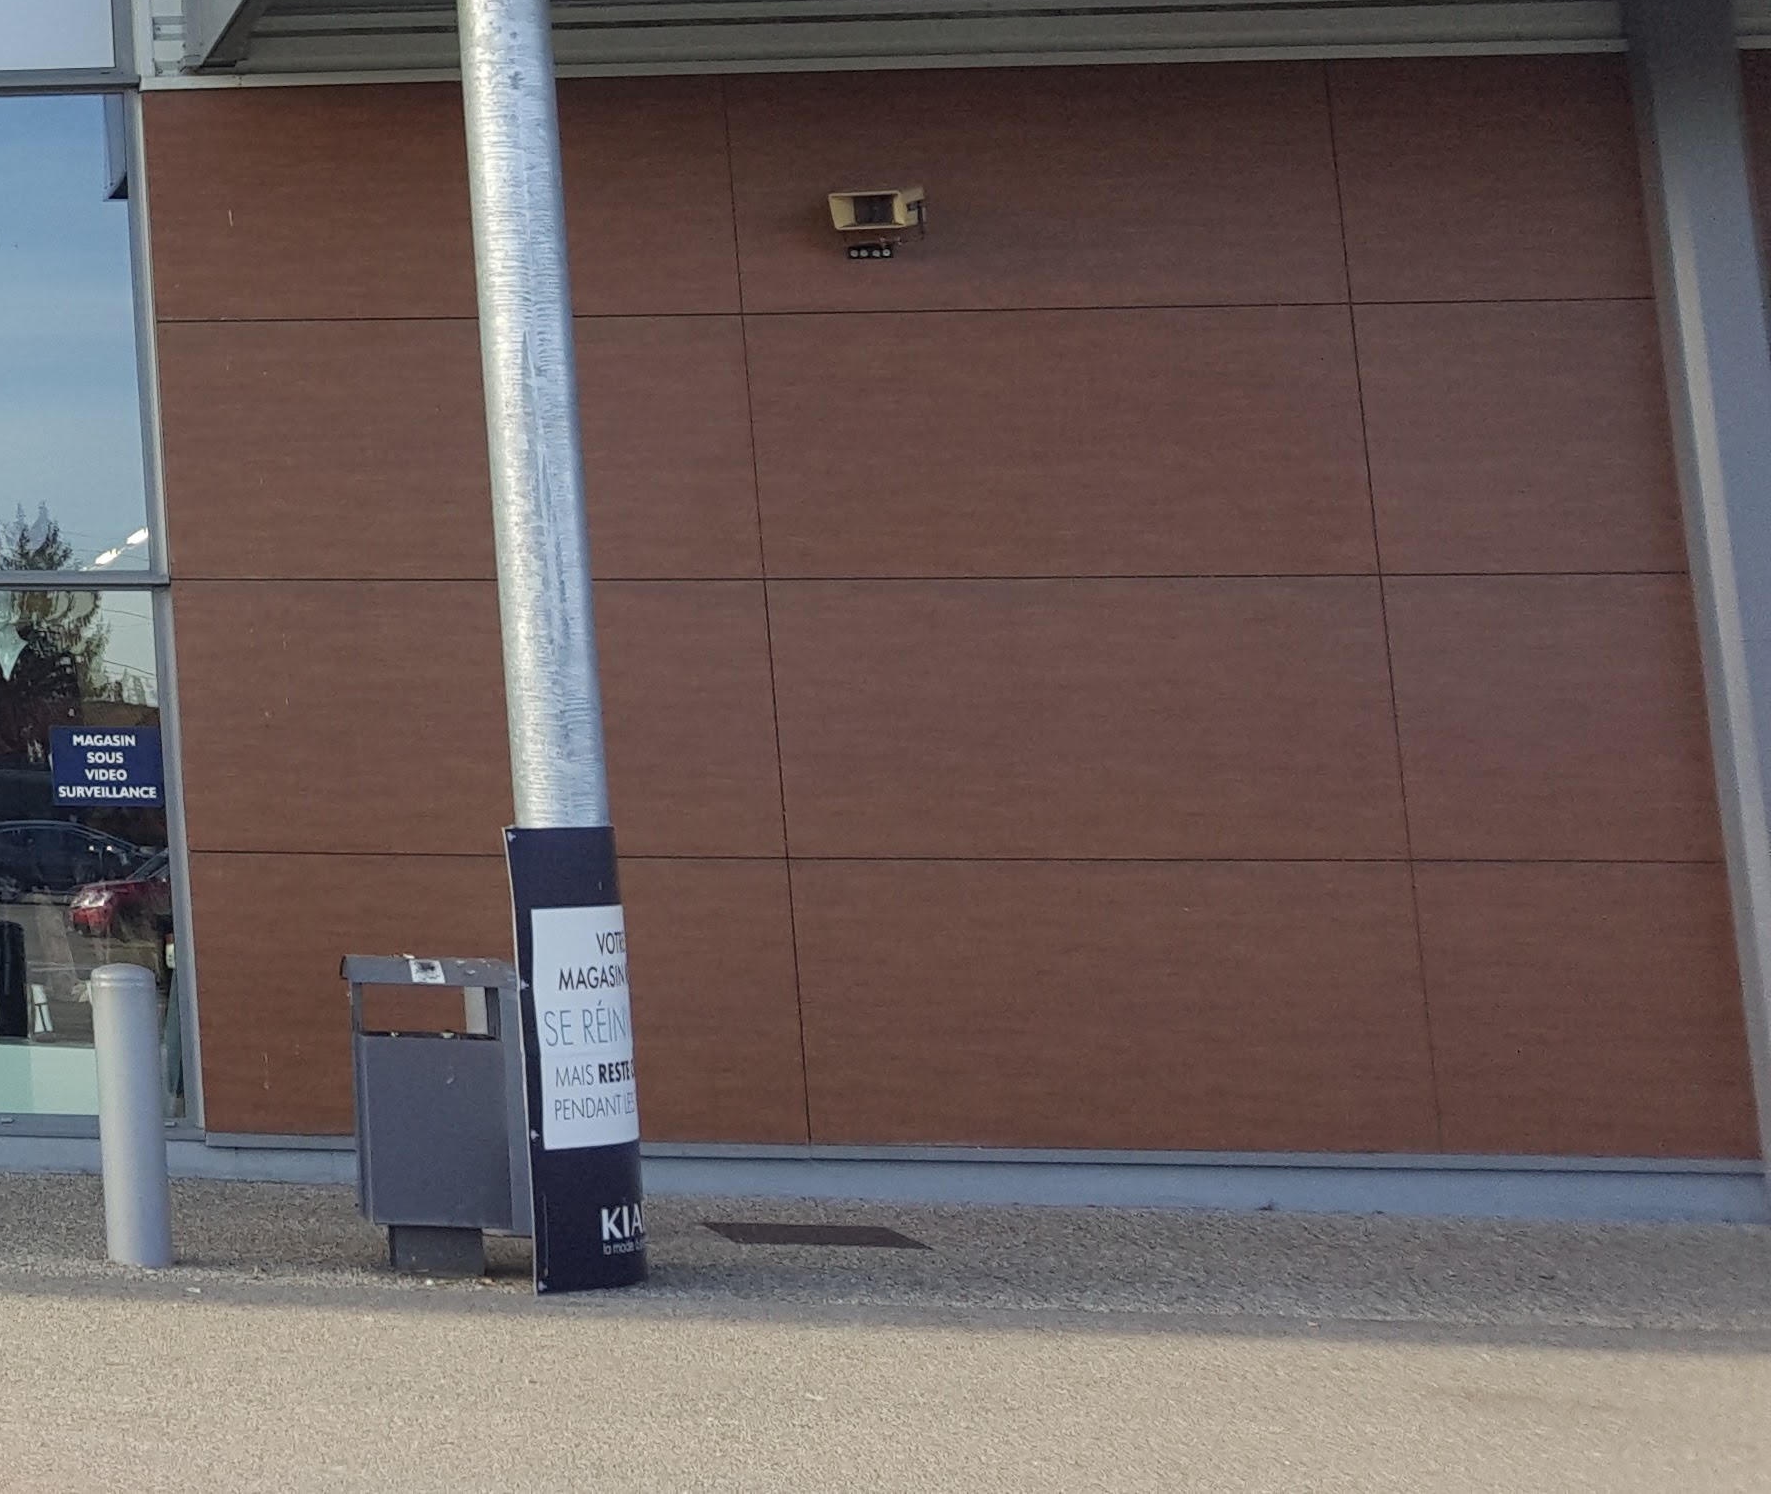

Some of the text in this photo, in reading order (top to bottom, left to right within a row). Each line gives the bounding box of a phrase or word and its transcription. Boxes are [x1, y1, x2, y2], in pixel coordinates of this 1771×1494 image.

[72, 734, 136, 746] MAGASIN
[86, 751, 124, 764] SOUS
[84, 769, 128, 781] VIDEO
[58, 786, 157, 798] SURVEILLANCE
[558, 964, 625, 991] MAGASIN
[543, 1009, 574, 1047] SE
[555, 1063, 594, 1088] MAIS
[598, 1060, 630, 1084] RESTE
[554, 1094, 621, 1121] PENDANT
[601, 1203, 643, 1241] KIA
